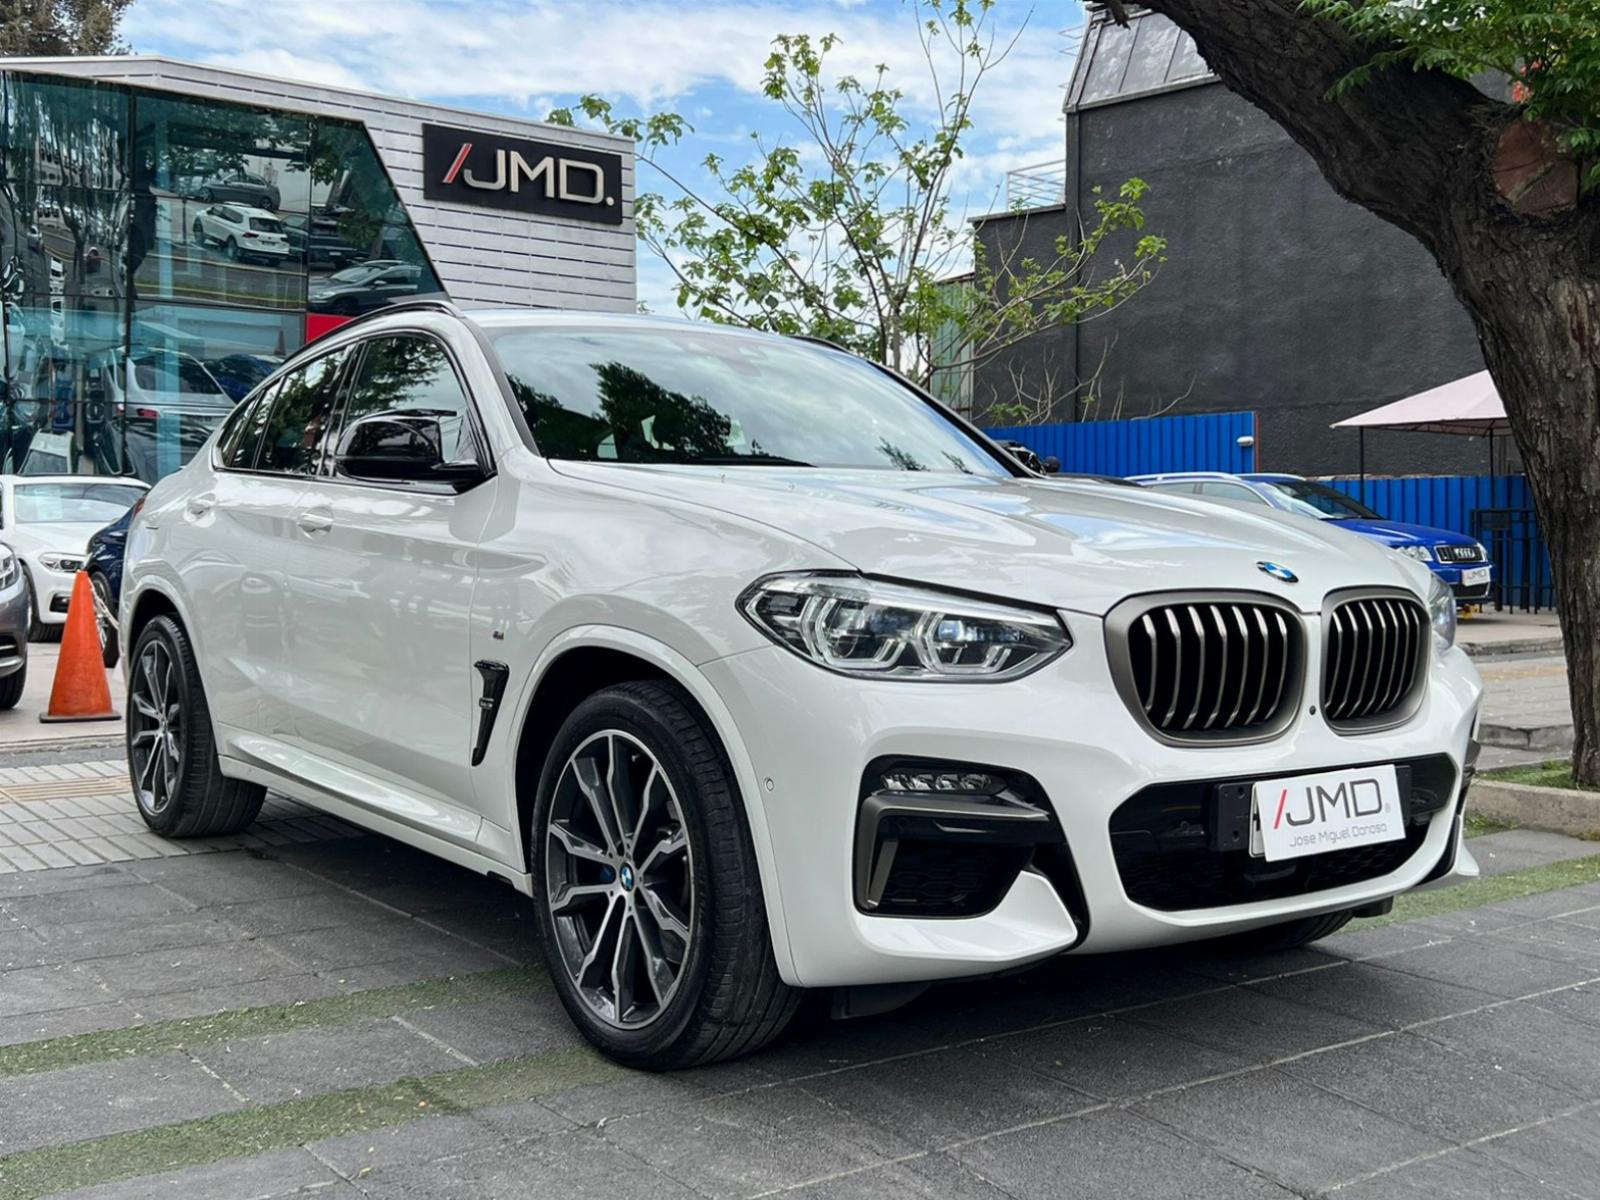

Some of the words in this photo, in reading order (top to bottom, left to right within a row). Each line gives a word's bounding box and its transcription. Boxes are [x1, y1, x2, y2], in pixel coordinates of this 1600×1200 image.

[1289, 834, 1317, 848] Jose
[1318, 827, 1350, 844] Miguel
[1352, 823, 1388, 838] Donoso
